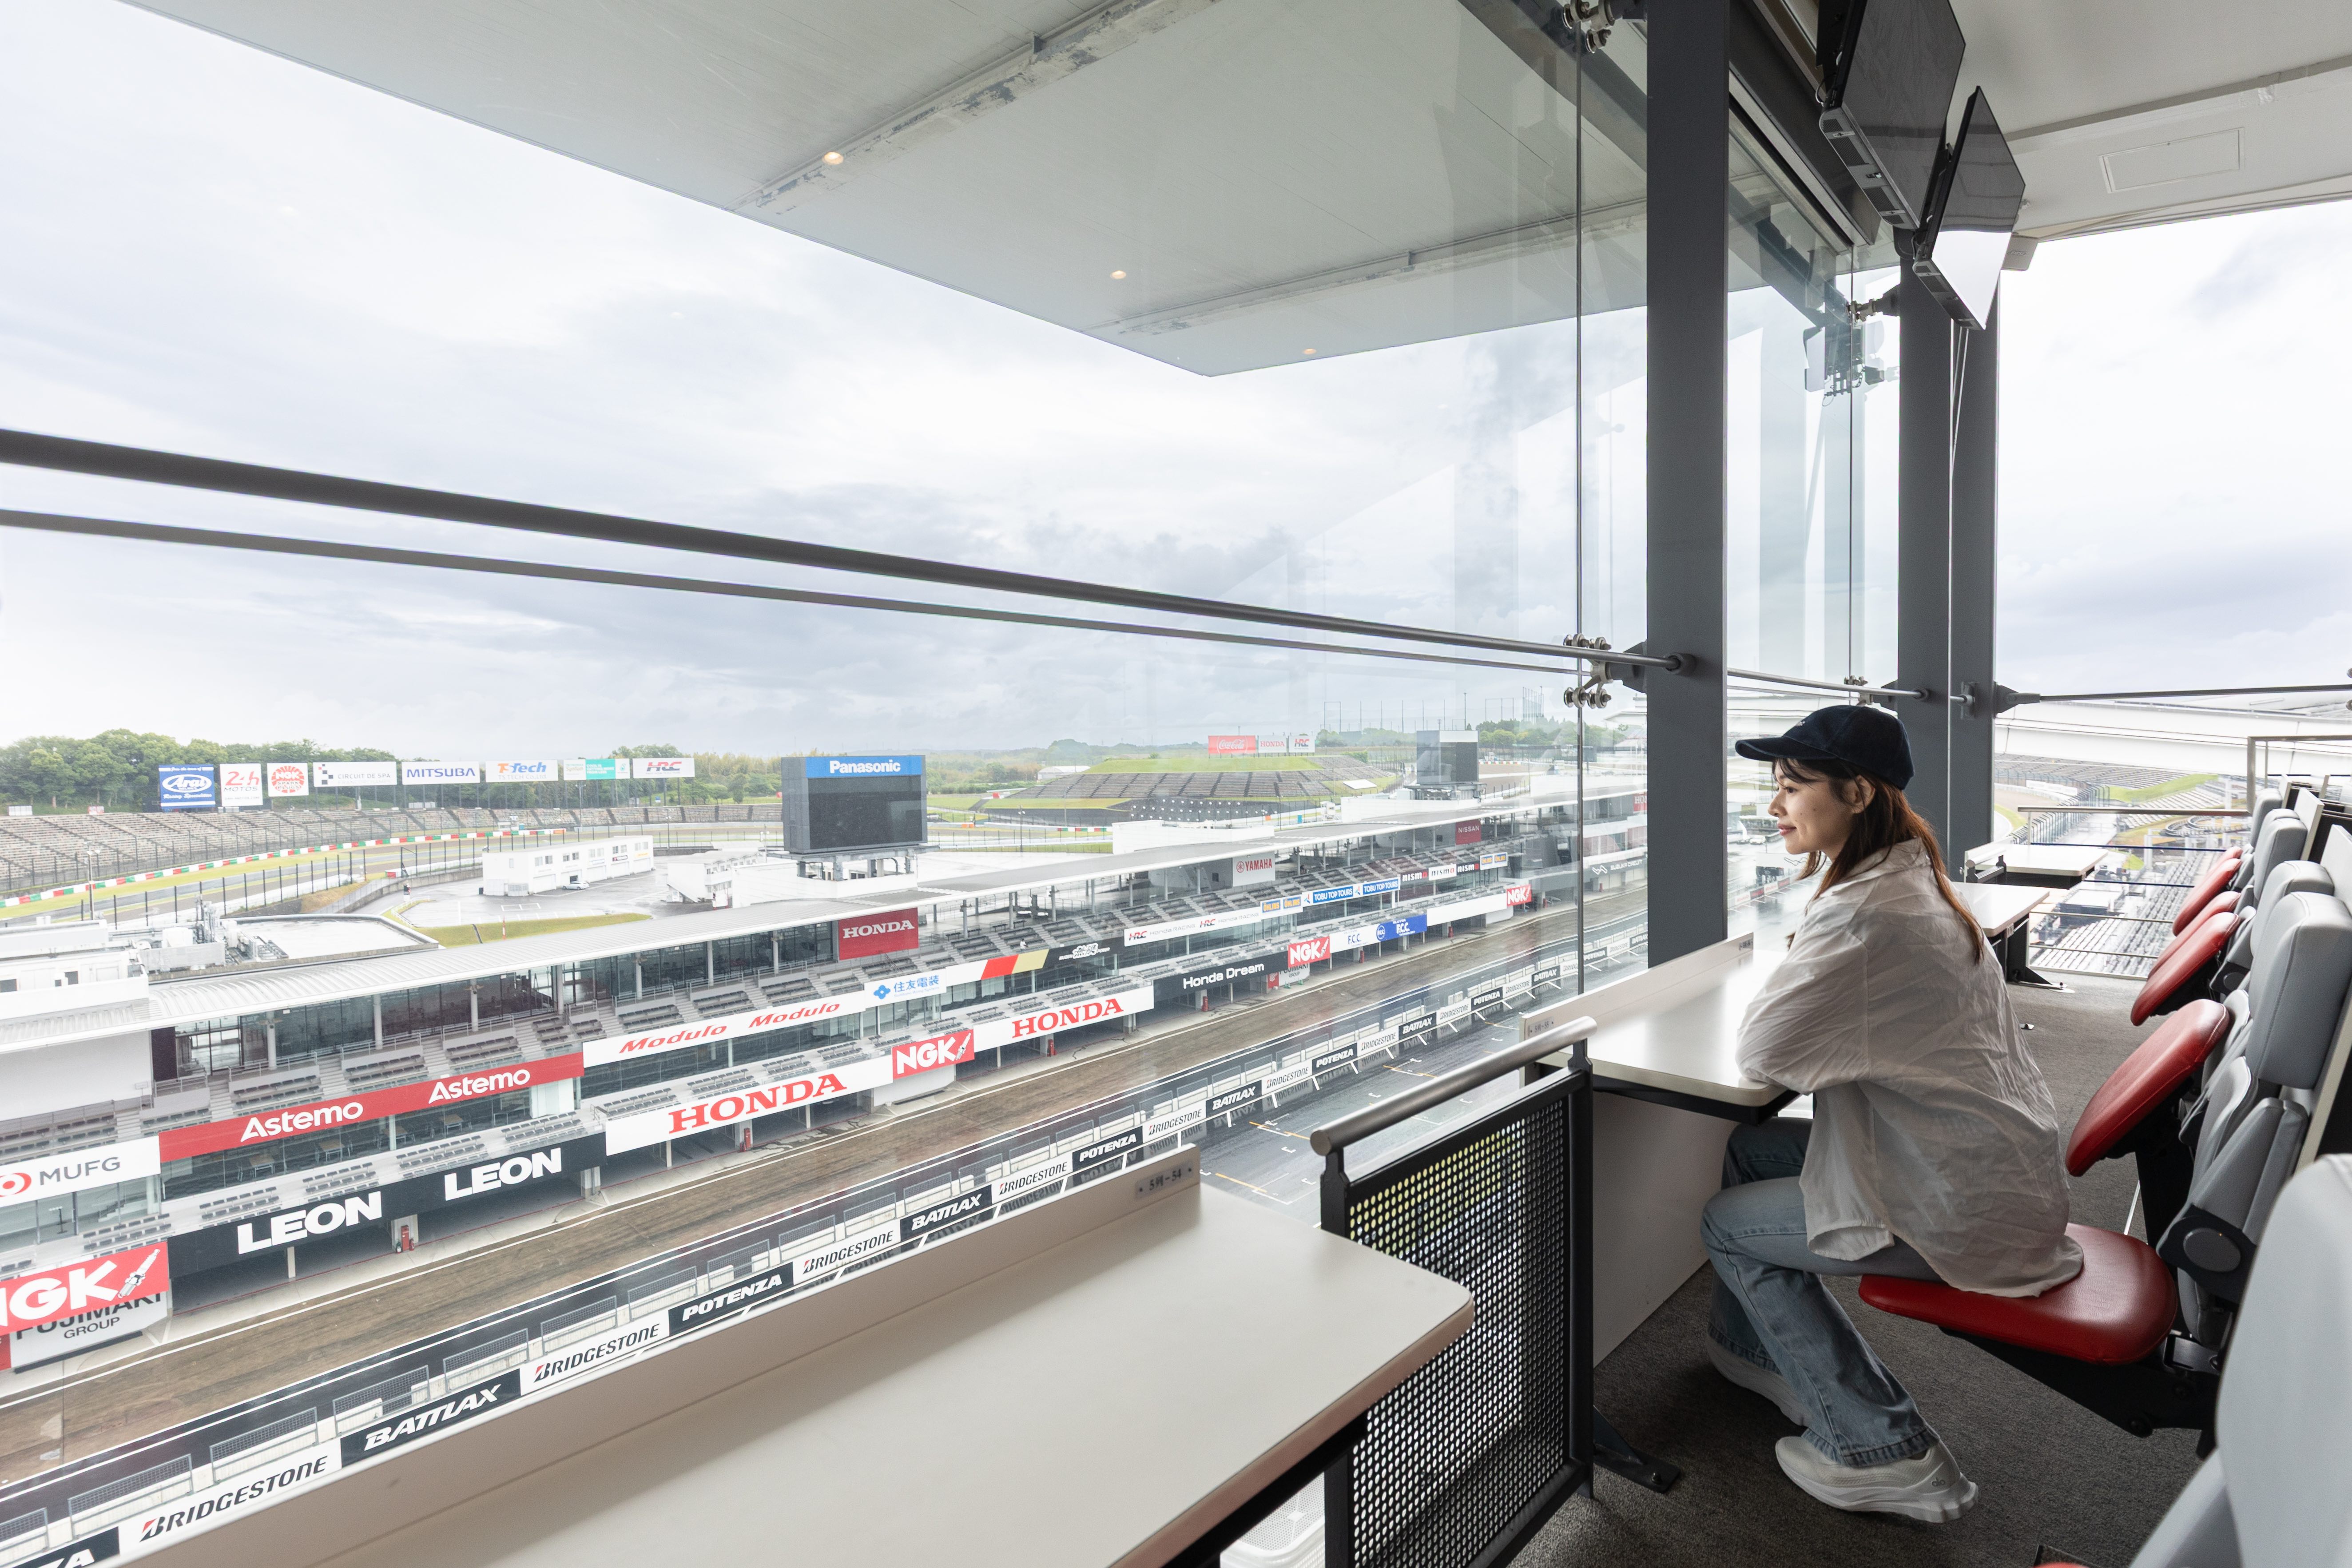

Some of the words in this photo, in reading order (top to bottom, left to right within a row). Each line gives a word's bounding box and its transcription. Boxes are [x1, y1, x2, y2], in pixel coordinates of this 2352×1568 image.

[407, 768, 475, 778] MITSUBA
[647, 761, 682, 771] HRC
[830, 759, 901, 774] Panasonic
[167, 776, 206, 788] Arai
[1245, 858, 1272, 871] YAMAHA
[1431, 868, 1454, 877] nismo
[1458, 863, 1479, 873] nismo
[1385, 880, 1398, 889] TOURS
[1402, 871, 1427, 882] nismo
[1314, 893, 1327, 901] TOBU
[1338, 888, 1352, 897] TOURS
[1507, 887, 1526, 905] NGK
[843, 920, 914, 939] HONDA
[1200, 919, 1216, 928] HRC
[1129, 931, 1147, 941] HRC
[1347, 933, 1362, 945] F.C.C.
[1290, 941, 1321, 965] NGK
[894, 975, 939, 992] 住友電装
[1183, 972, 1224, 989] Honda
[1226, 963, 1264, 979] Dream
[1506, 979, 1530, 994] BRIDGESTONE
[1474, 991, 1500, 1005] POTENZA
[748, 1003, 840, 1028] Modulo
[1012, 998, 1124, 1038] HONDA
[1439, 1003, 1469, 1020] BRIDGESTONE
[619, 1025, 727, 1053] Modulo
[1361, 1032, 1396, 1052] BRIDGESTONE
[897, 1036, 956, 1074] NGK
[1316, 1048, 1354, 1068] POTENZA
[428, 1069, 530, 1105] Astemo
[1267, 1066, 1309, 1089] BRIDGESTONE
[668, 1073, 847, 1134] HONDA
[240, 1101, 363, 1143] Astemo
[1148, 1108, 1202, 1136] BRIDGESTONE
[1079, 1134, 1137, 1162] POTENZA
[40, 1157, 121, 1185] MUFG
[445, 1147, 561, 1201] LEON
[998, 1161, 1068, 1196] BRIDGESTONE
[237, 1191, 382, 1254] LEON
[803, 1230, 893, 1274] BRIDGESTONE
[0, 1260, 119, 1327] GK
[682, 1274, 783, 1322] POTENZA
[64, 1317, 120, 1339] GROUP
[534, 1323, 660, 1383] BRIDGESTONE
[364, 1384, 501, 1452] BATTLAX
[140, 1455, 328, 1543] BRIDGESTONE
